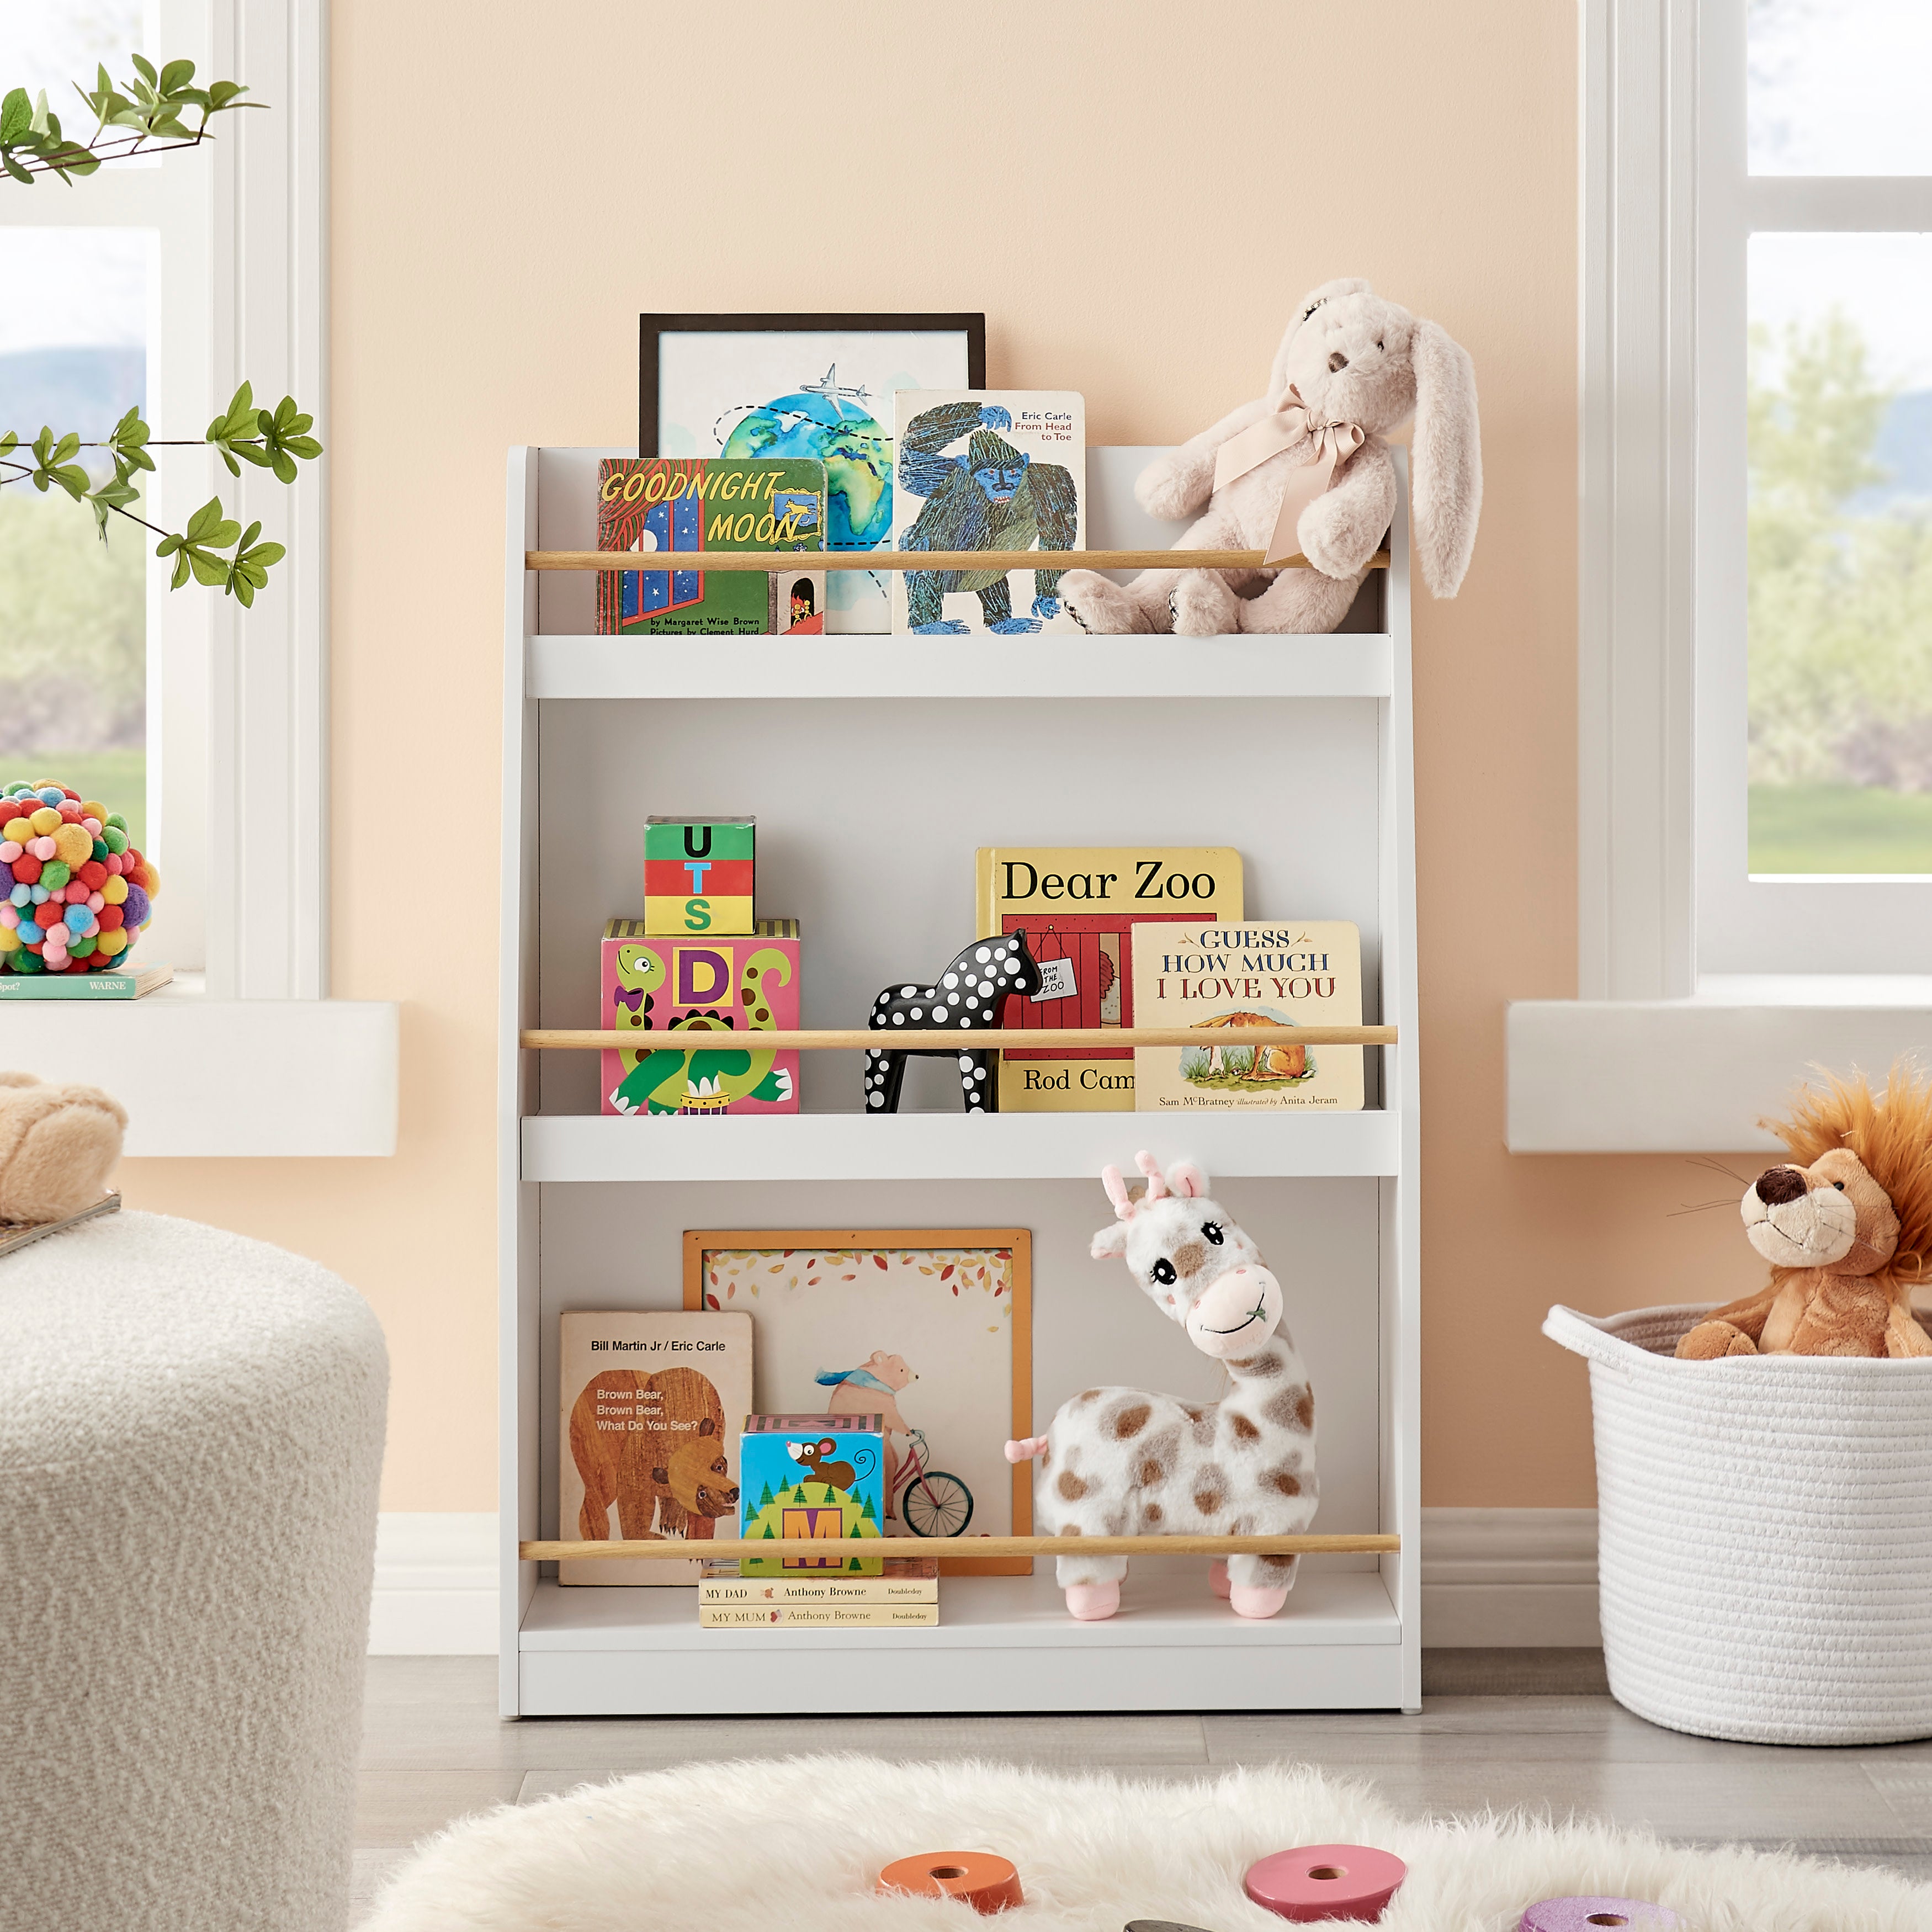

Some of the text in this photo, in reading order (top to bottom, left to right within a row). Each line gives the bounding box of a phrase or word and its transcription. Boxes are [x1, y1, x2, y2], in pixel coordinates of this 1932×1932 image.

[1045, 412, 1072, 420] Carle
[602, 471, 786, 502] GOODNIGHT
[707, 513, 803, 543] MOON
[650, 617, 760, 627] by Margaret Wise Brown
[684, 826, 712, 858] U
[684, 862, 712, 894] T
[1001, 861, 1216, 900] Dear Zoo
[684, 899, 712, 931] S
[1200, 930, 1290, 949] GUESS
[1162, 953, 1330, 973] HOW MUCH
[679, 950, 729, 1004] D
[1044, 973, 1058, 983] THE
[89, 981, 126, 990] WARNE
[1042, 981, 1064, 994] ZOO
[1157, 977, 1336, 1000] I LOVE YOU
[1023, 1069, 1134, 1090] Rod Cam
[1159, 1097, 1179, 1106] Sam
[1183, 1096, 1234, 1107] McBratney
[1280, 1096, 1305, 1105] Anita
[1309, 1096, 1338, 1105] Jeram
[591, 1341, 608, 1351] Bill
[612, 1341, 647, 1351] Martin
[650, 1341, 662, 1351] Jr
[671, 1341, 693, 1351] Eric
[696, 1341, 726, 1351] Carle
[597, 1389, 664, 1401] Brown Bear,
[597, 1405, 664, 1416] Brown Bear,
[597, 1420, 698, 1431] What Do You See?
[784, 1511, 841, 1566] M
[705, 1590, 721, 1599] MY
[725, 1589, 747, 1598] DAD
[784, 1588, 826, 1599] Anthony
[830, 1587, 867, 1596] Browne
[712, 1613, 730, 1622] MY
[735, 1612, 766, 1622] MUM
[788, 1611, 831, 1622] Anthony
[834, 1611, 871, 1620] Browne
